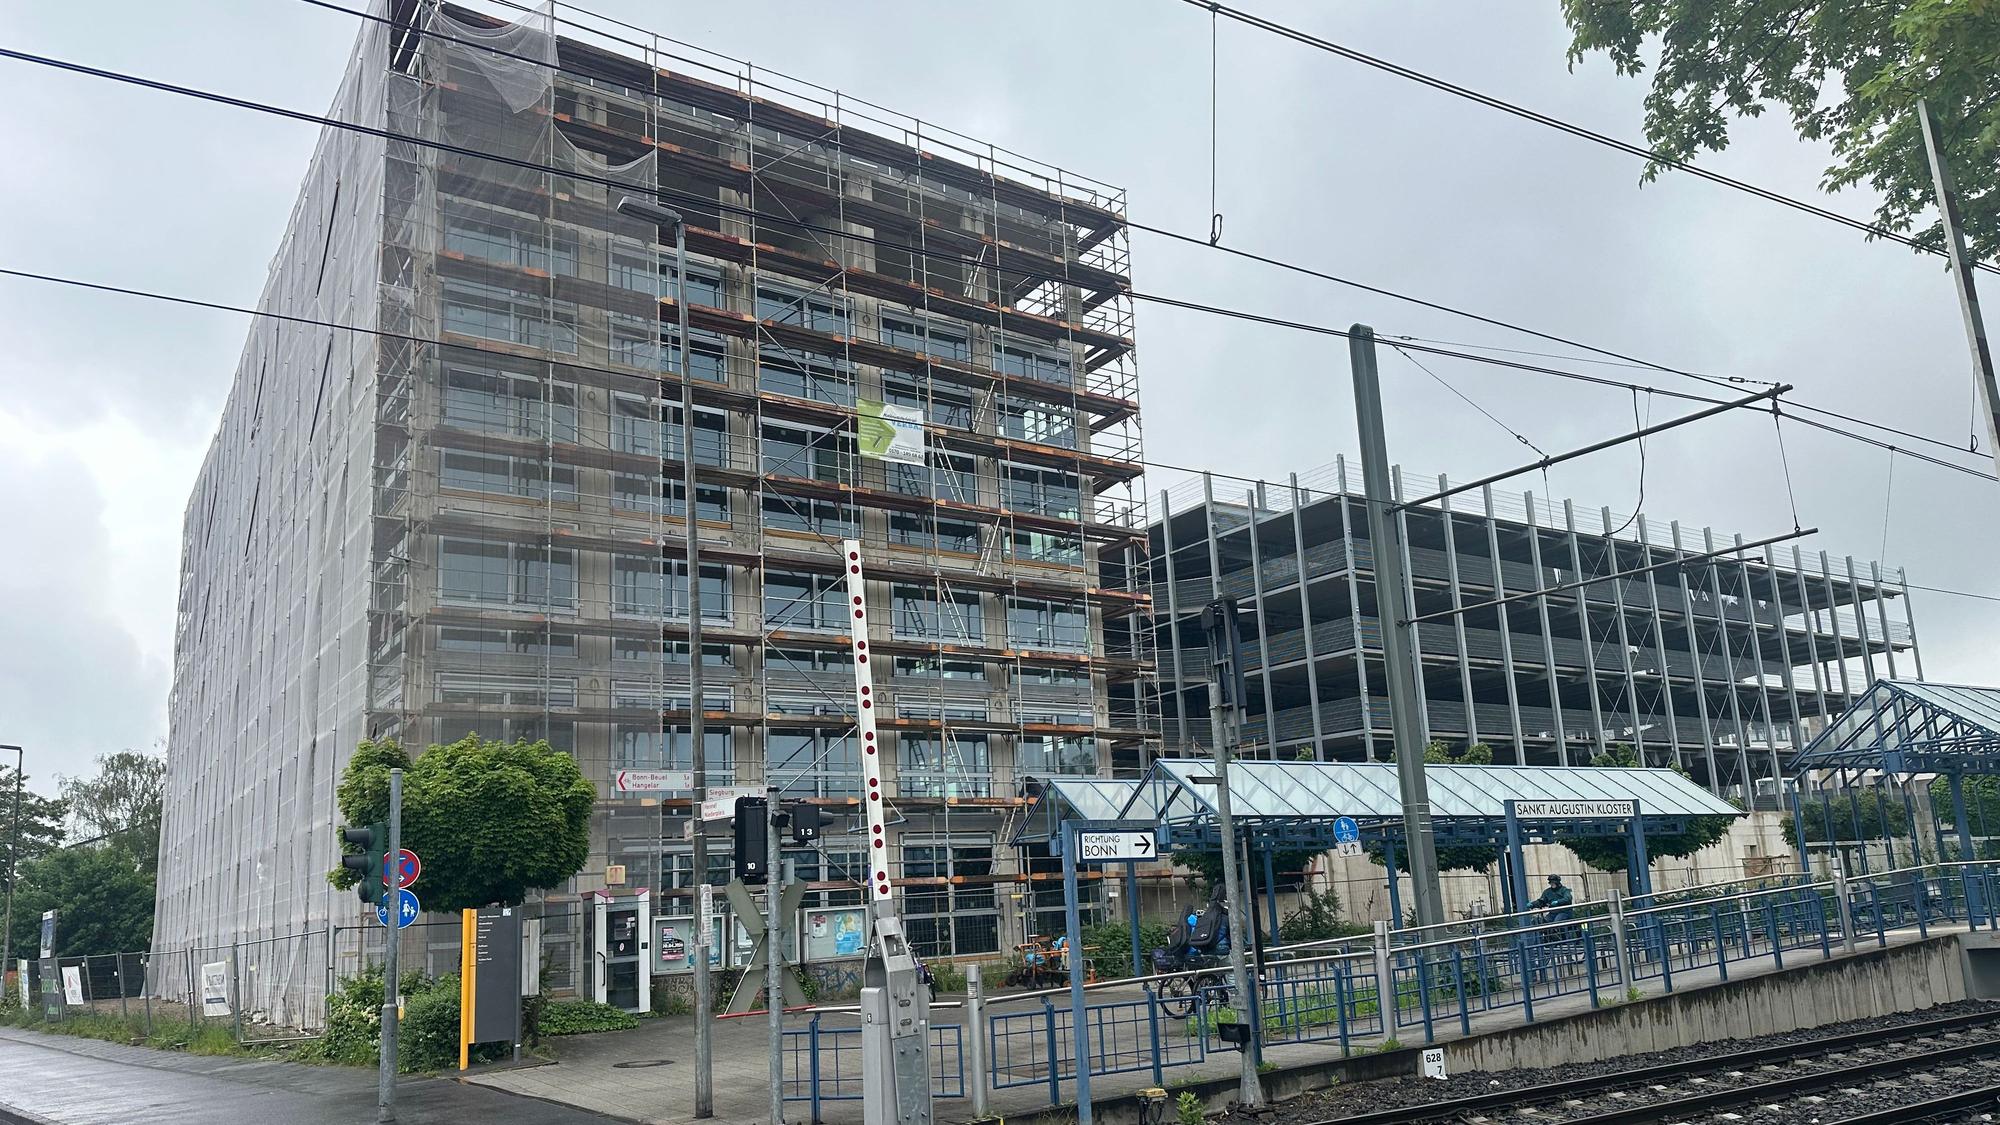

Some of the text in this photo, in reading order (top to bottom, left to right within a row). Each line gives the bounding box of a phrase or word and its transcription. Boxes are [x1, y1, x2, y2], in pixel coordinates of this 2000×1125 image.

[709, 789, 735, 797] Siegburg
[1517, 803, 1633, 815] SANKT AUGUSTIN KLOSTER
[800, 828, 813, 836] 13
[1084, 835, 1121, 843] RICHTUNG
[1085, 845, 1118, 857] BONN
[746, 862, 756, 870] 10
[1426, 1053, 1441, 1063] 628
[1437, 1065, 1442, 1074] 7
